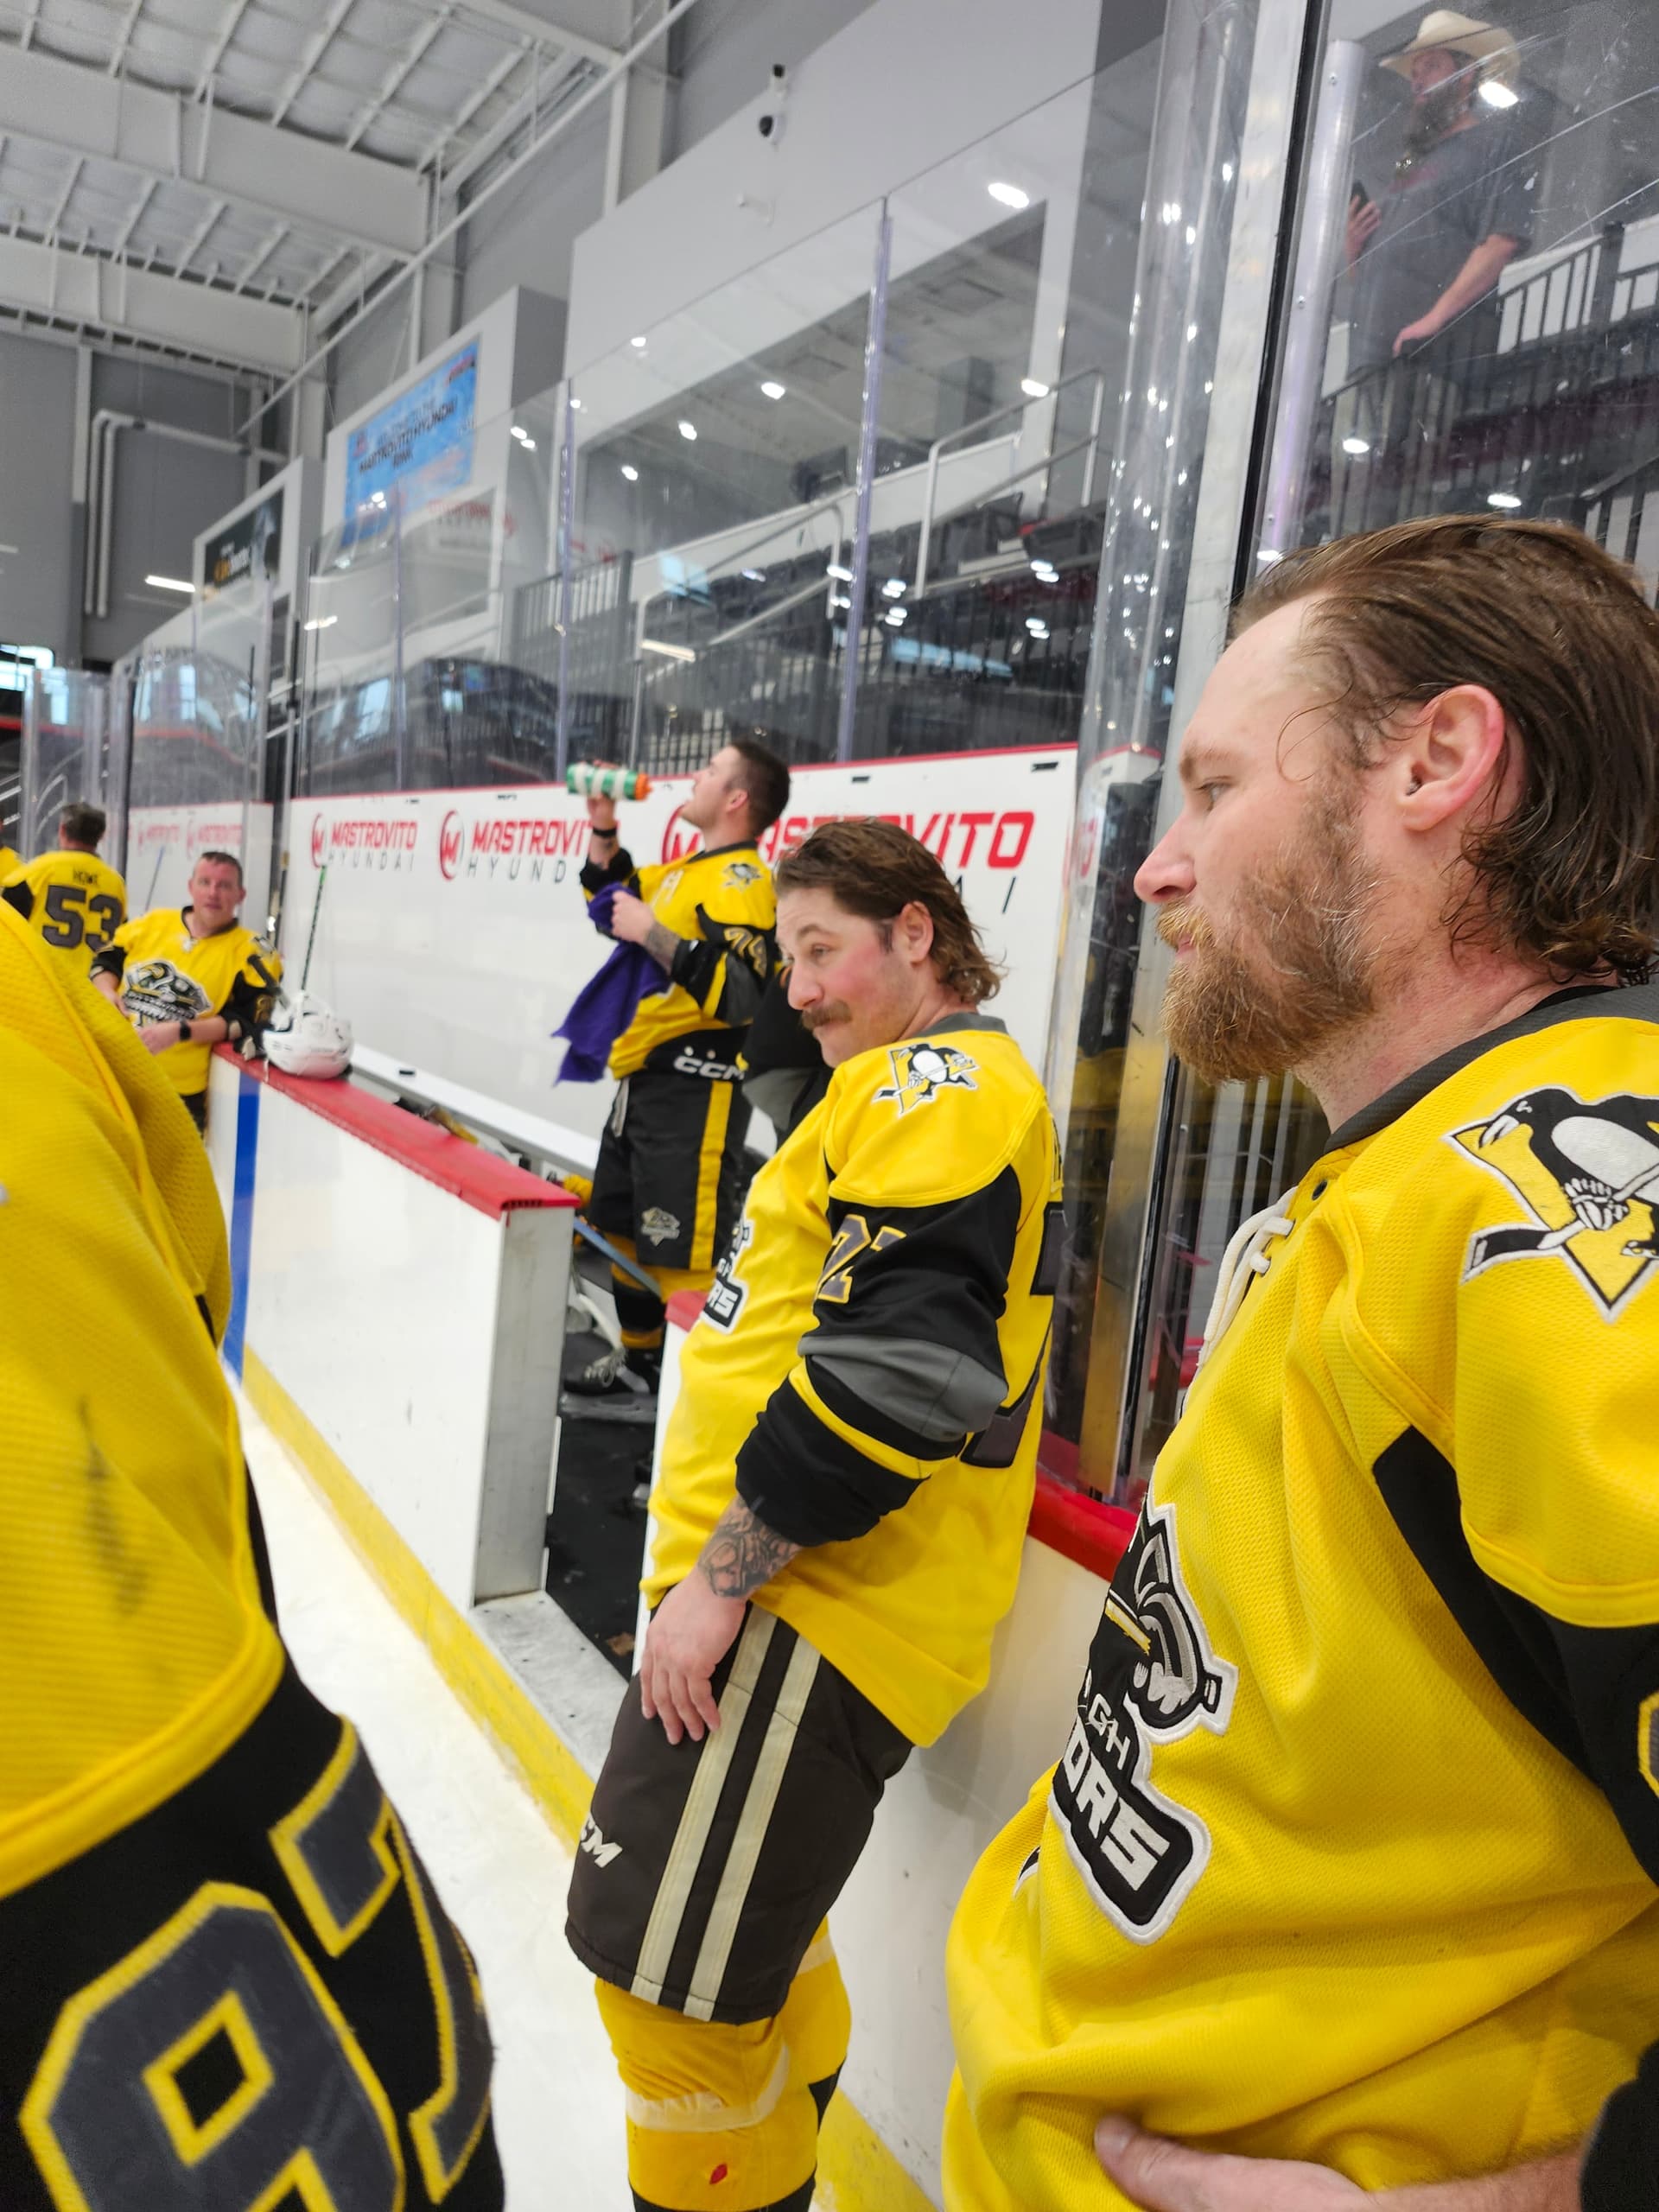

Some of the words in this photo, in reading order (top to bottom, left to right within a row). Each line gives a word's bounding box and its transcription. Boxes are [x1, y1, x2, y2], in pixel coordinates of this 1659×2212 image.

[331, 820, 418, 850] MASTROVITO
[328, 849, 415, 871] HYUNDAI
[467, 856, 567, 883] HYUND
[41, 885, 124, 952] 53
[674, 1055, 745, 1080] CCM
